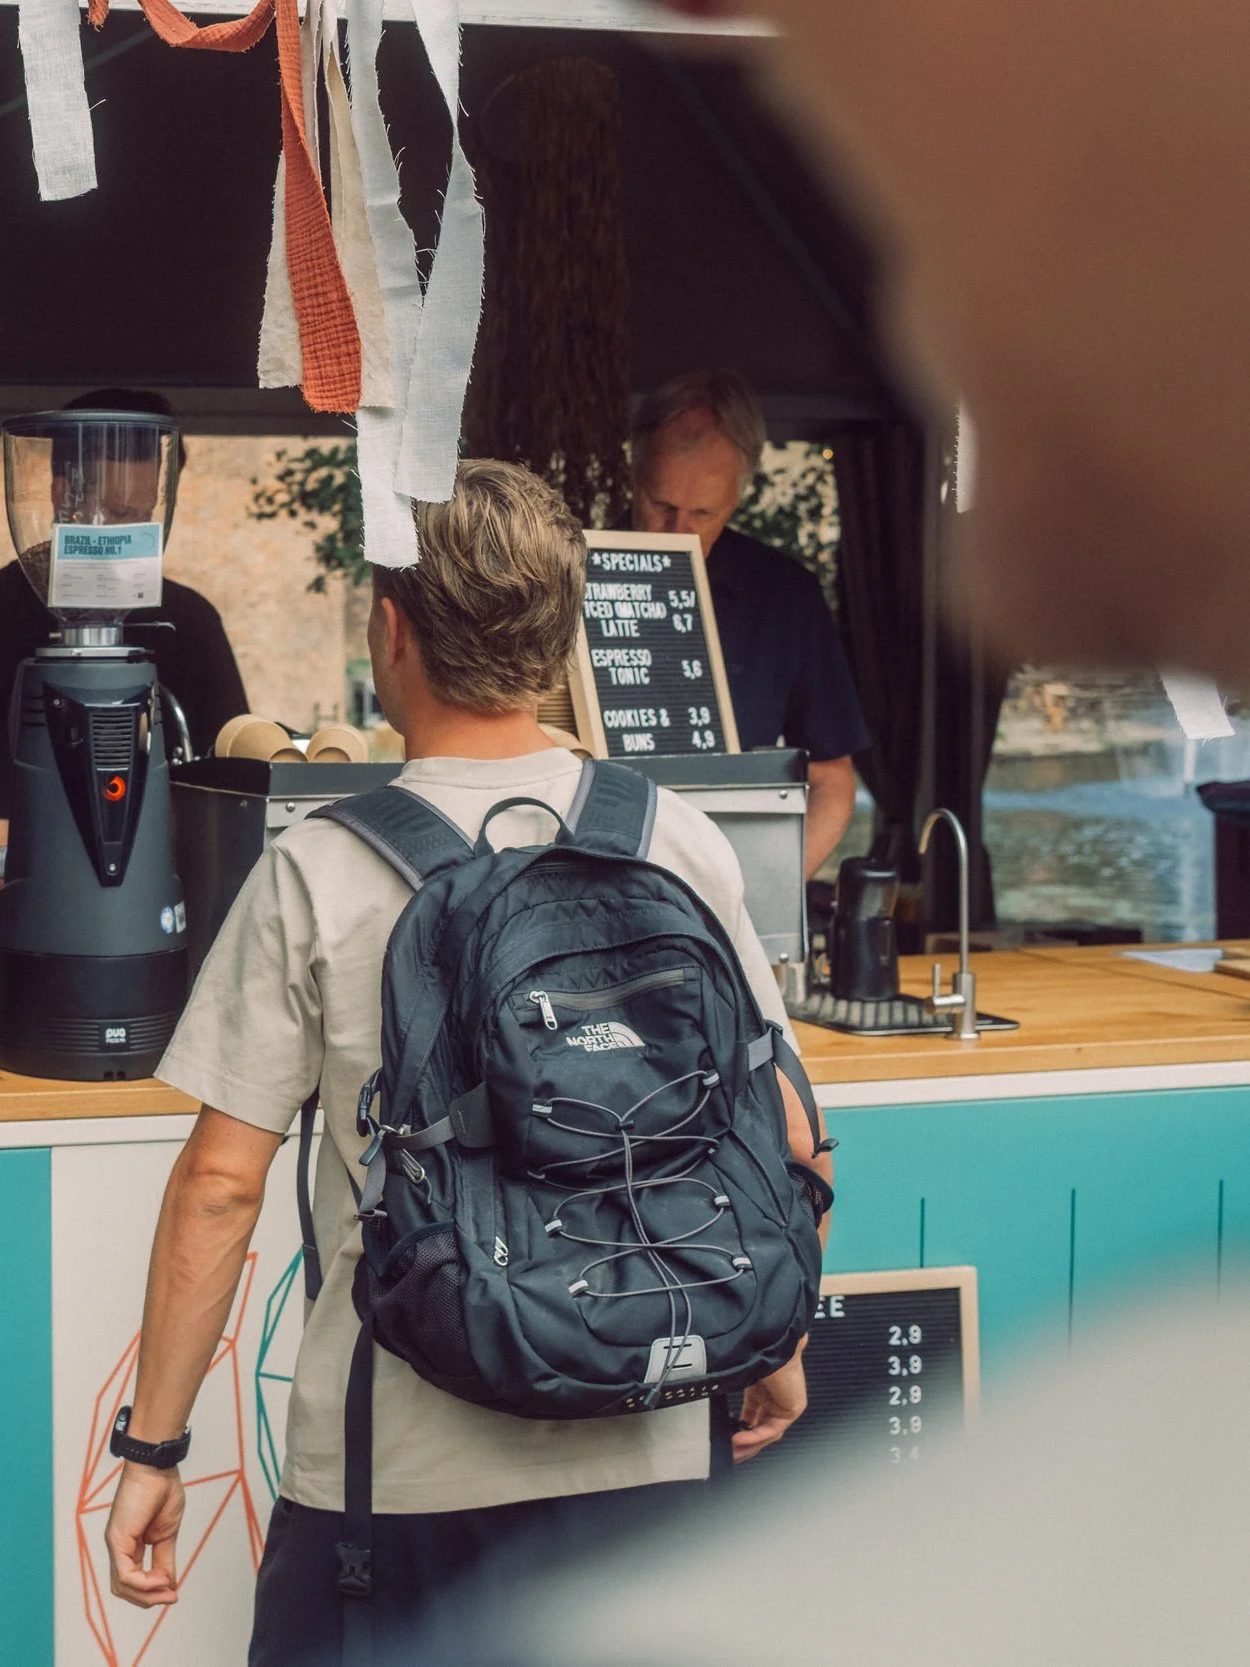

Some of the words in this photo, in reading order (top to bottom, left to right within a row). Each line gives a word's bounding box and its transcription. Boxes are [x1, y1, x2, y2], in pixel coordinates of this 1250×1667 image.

[64, 535, 92, 546] BRAZIL
[97, 535, 132, 546] ETHIOPIA
[64, 545, 103, 556] ESPRESSO
[585, 582, 652, 601] TRAWBERRY
[601, 619, 641, 637] LATTE
[591, 649, 652, 667] ESPRESSO
[609, 667, 650, 685] TONIC
[603, 708, 658, 728] COOKIES
[622, 733, 656, 752] BUNS
[581, 1023, 610, 1035] THE
[565, 1034, 614, 1047] NORTH
[583, 1041, 618, 1052] FACE
